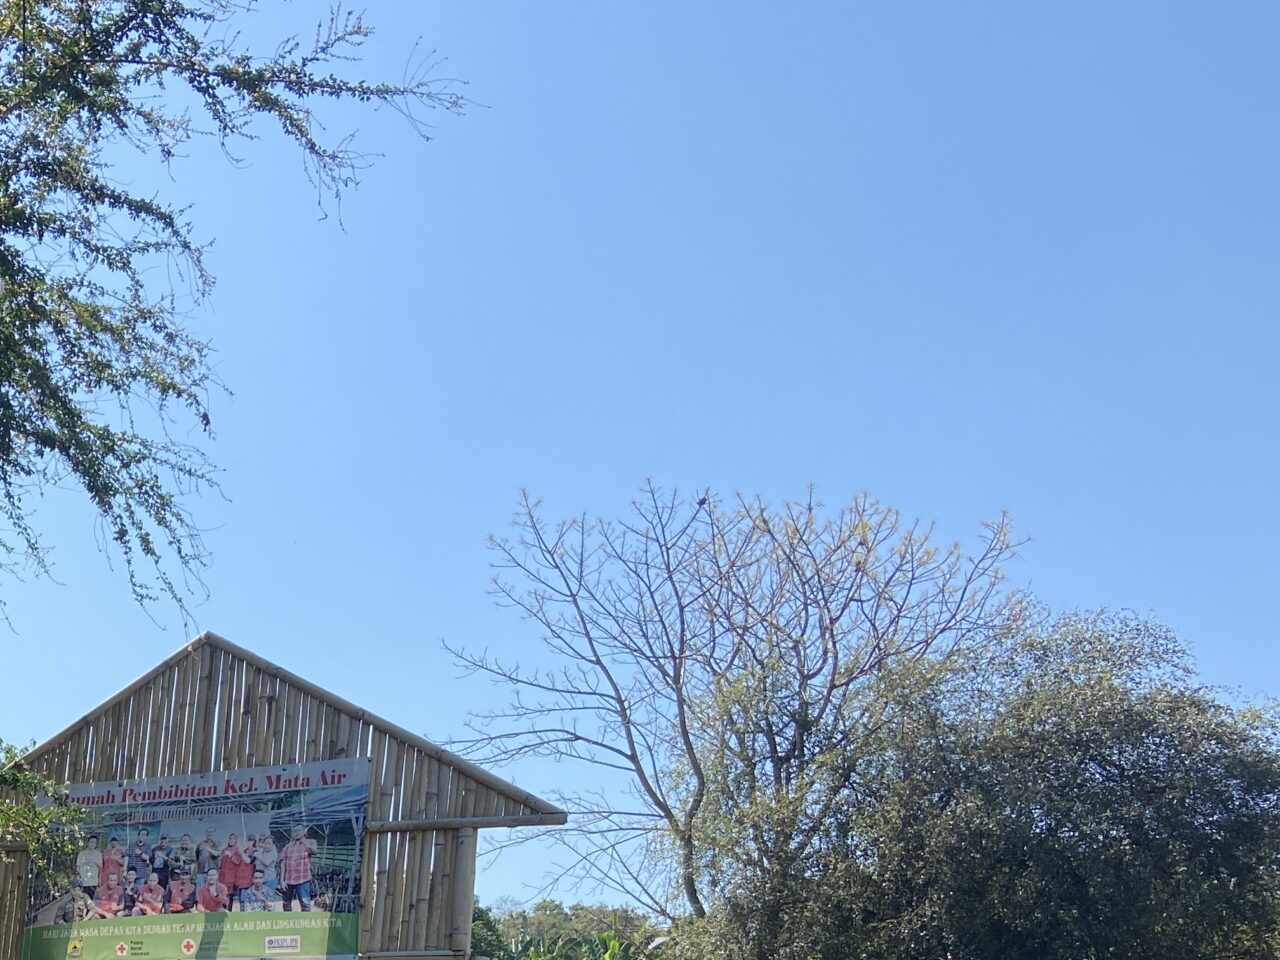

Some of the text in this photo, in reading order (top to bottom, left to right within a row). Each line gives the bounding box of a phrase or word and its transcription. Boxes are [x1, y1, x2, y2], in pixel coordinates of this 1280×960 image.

[122, 783, 217, 803] Pembibitan
[224, 777, 258, 794] Kel.
[266, 773, 310, 790] Mata
[316, 769, 347, 786] Air
[100, 927, 122, 936] DEPAN
[125, 926, 141, 935] KITA
[144, 925, 170, 934] DENGAN
[172, 923, 195, 933] TETAP
[233, 921, 254, 931] ALAM
[256, 920, 271, 930] DAN
[273, 919, 321, 929] LINGKUNGAN
[322, 918, 342, 928] KITA
